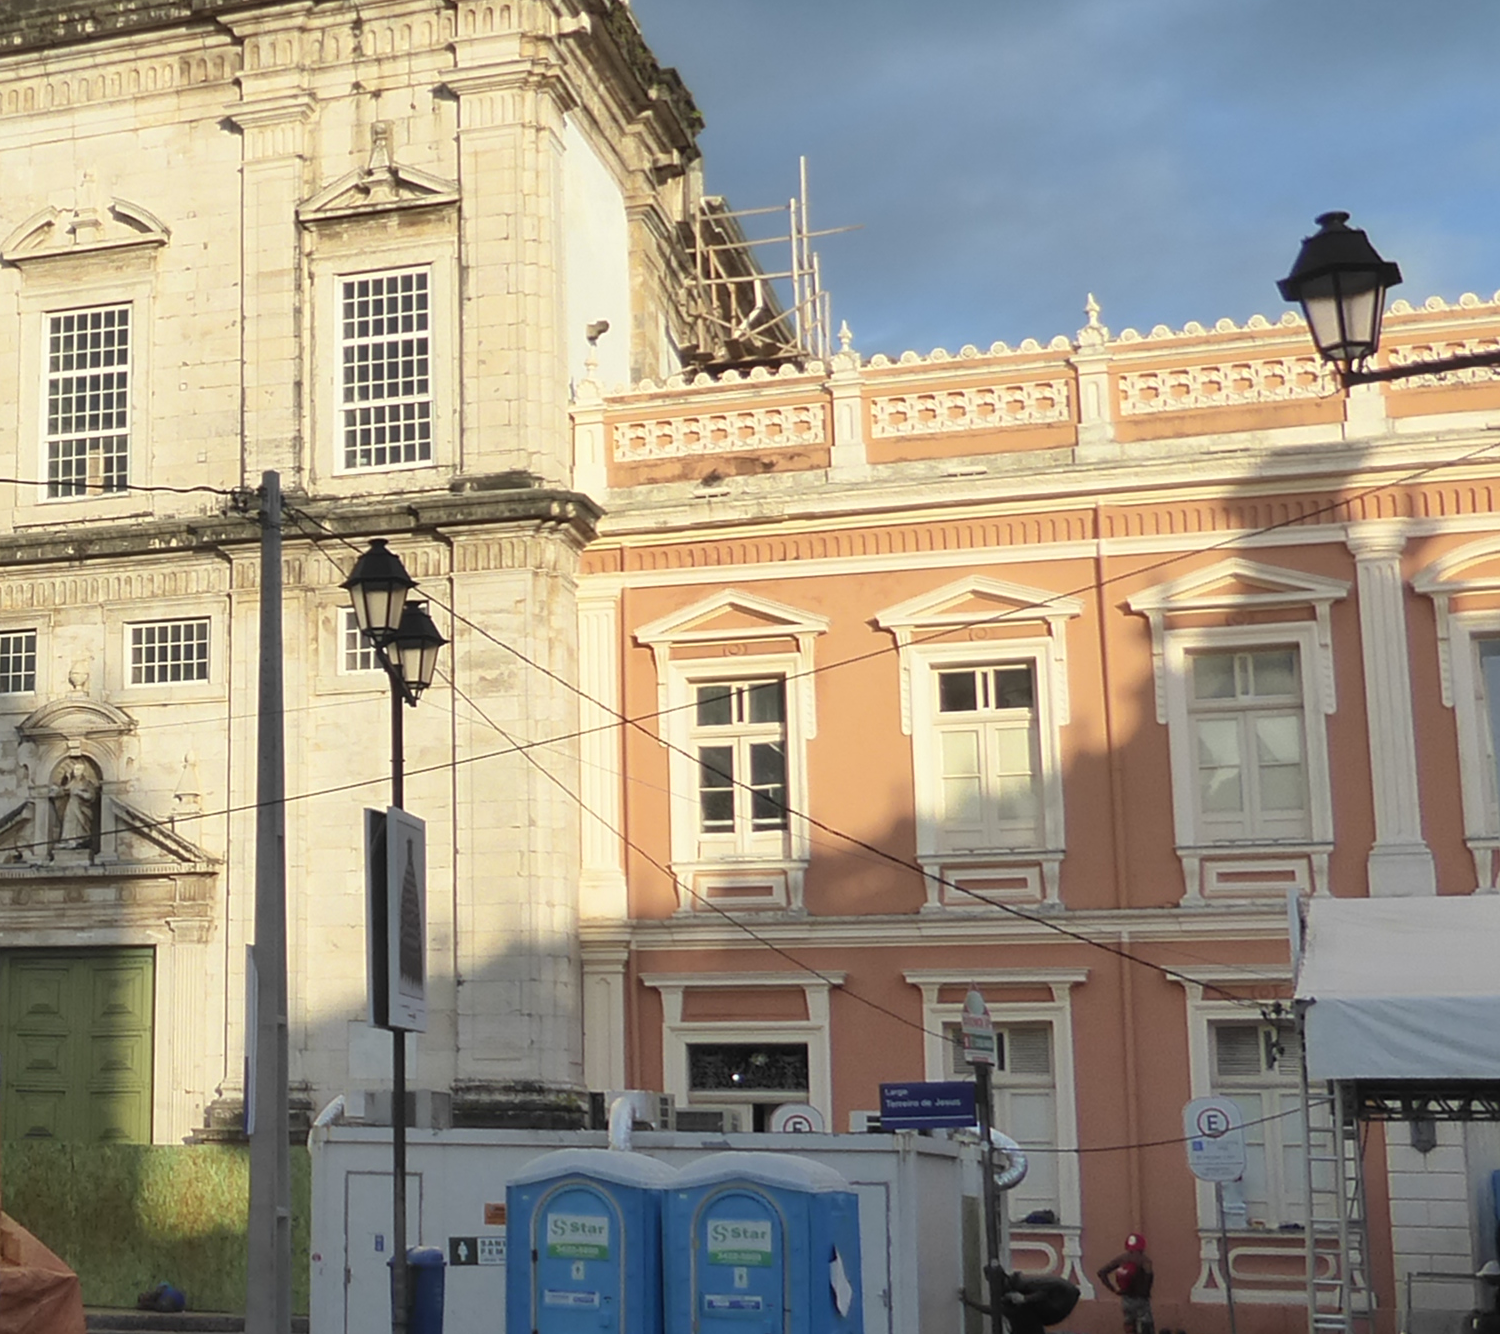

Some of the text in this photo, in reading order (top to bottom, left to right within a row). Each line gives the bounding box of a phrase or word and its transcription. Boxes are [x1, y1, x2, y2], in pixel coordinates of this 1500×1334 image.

[1207, 1114, 1219, 1131] E
[570, 1221, 605, 1235] Star
[731, 1227, 767, 1240] Star
